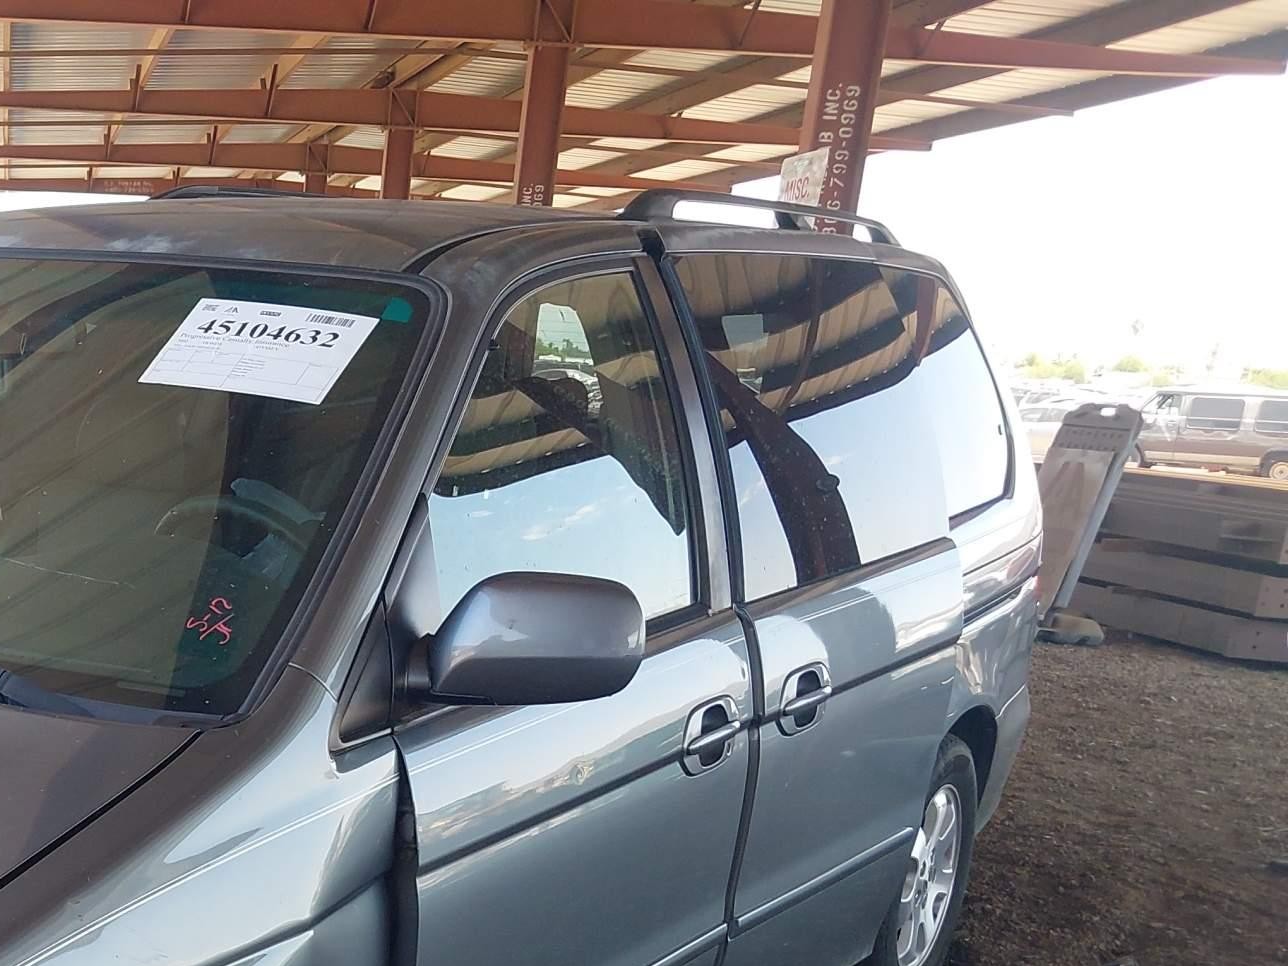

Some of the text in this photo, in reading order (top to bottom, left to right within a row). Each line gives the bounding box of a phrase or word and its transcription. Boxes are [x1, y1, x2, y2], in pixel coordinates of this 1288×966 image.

[822, 83, 843, 121] INC.
[785, 176, 810, 201] MISC.
[196, 317, 341, 350] 45104632
